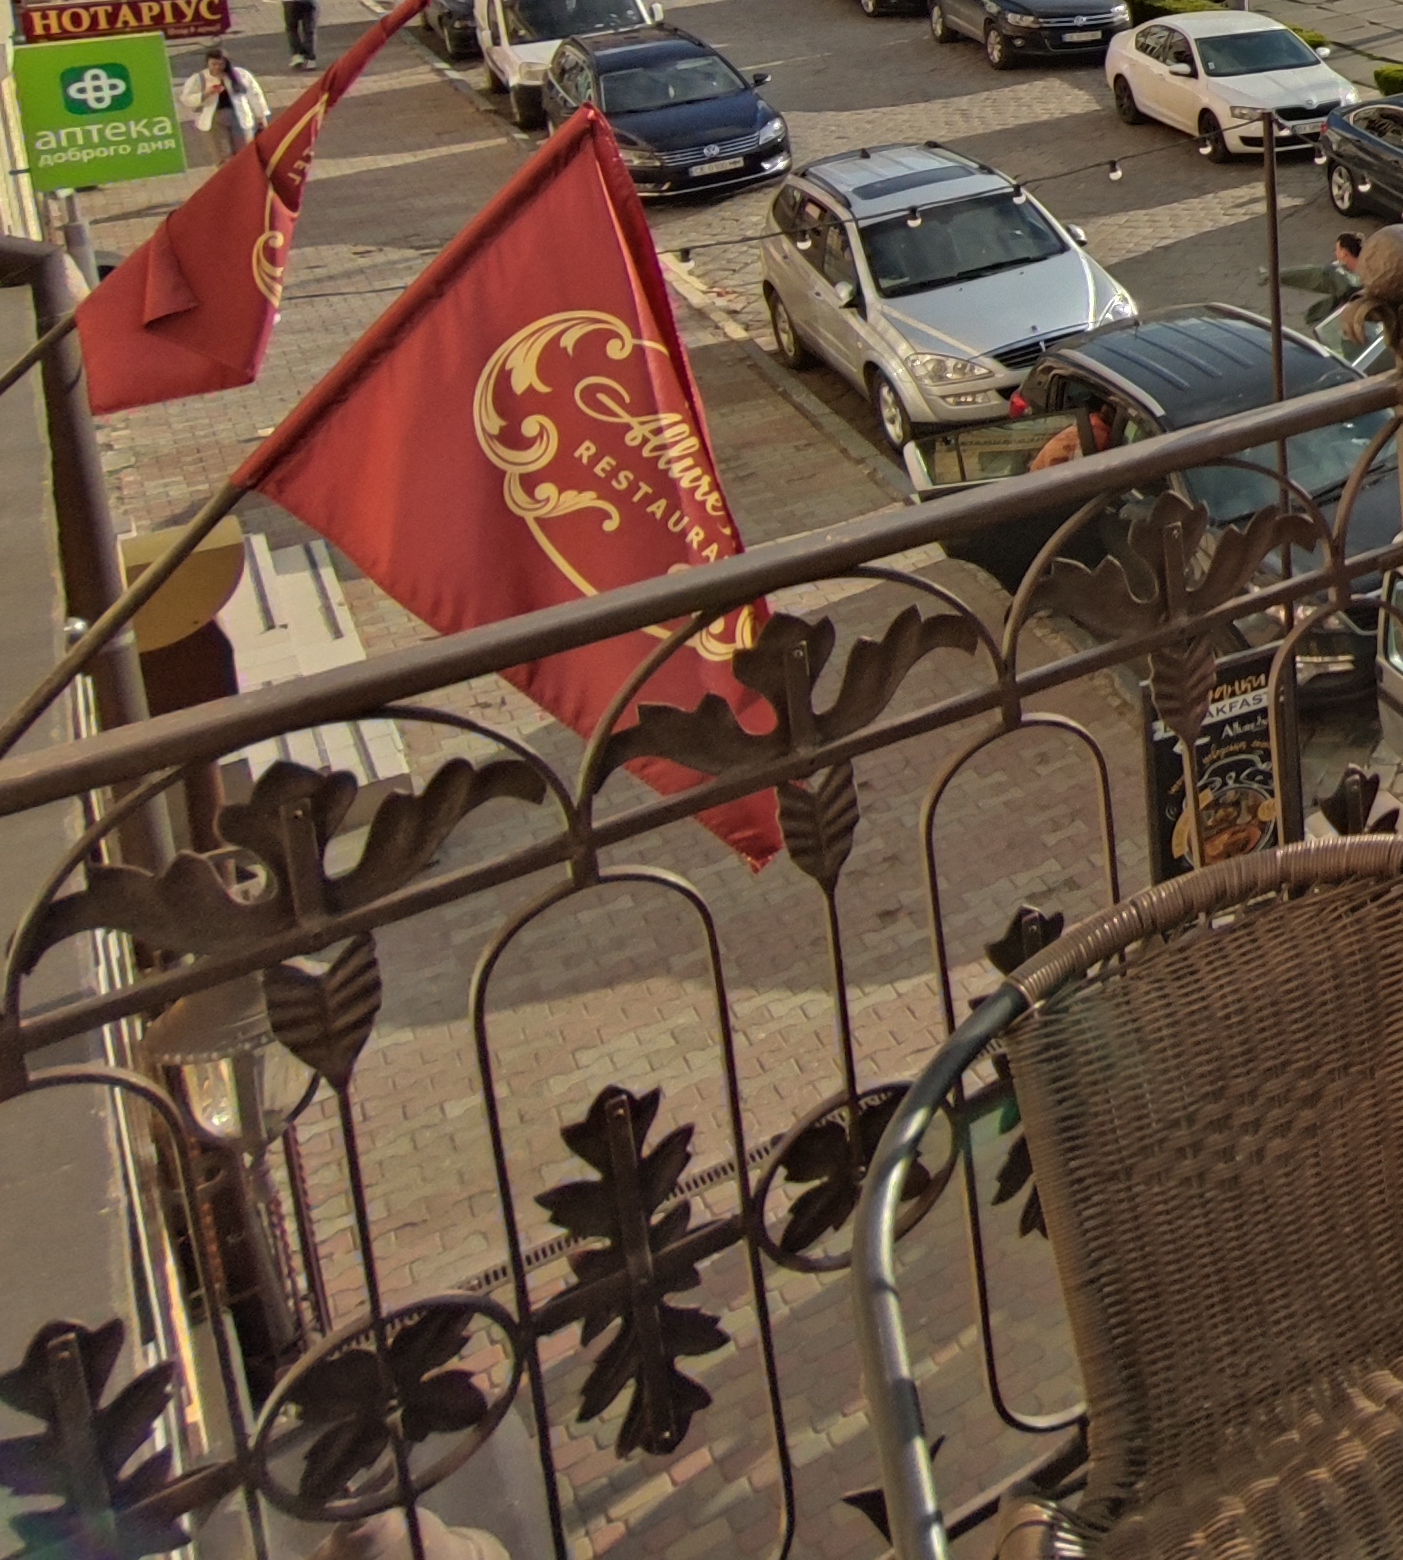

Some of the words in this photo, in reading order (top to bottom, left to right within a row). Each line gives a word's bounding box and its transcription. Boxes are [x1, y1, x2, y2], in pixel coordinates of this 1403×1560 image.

[35, 116, 173, 151] аптека
[38, 144, 131, 168] доброго
[136, 139, 176, 155] дня
[573, 440, 731, 563] RESTAURA
